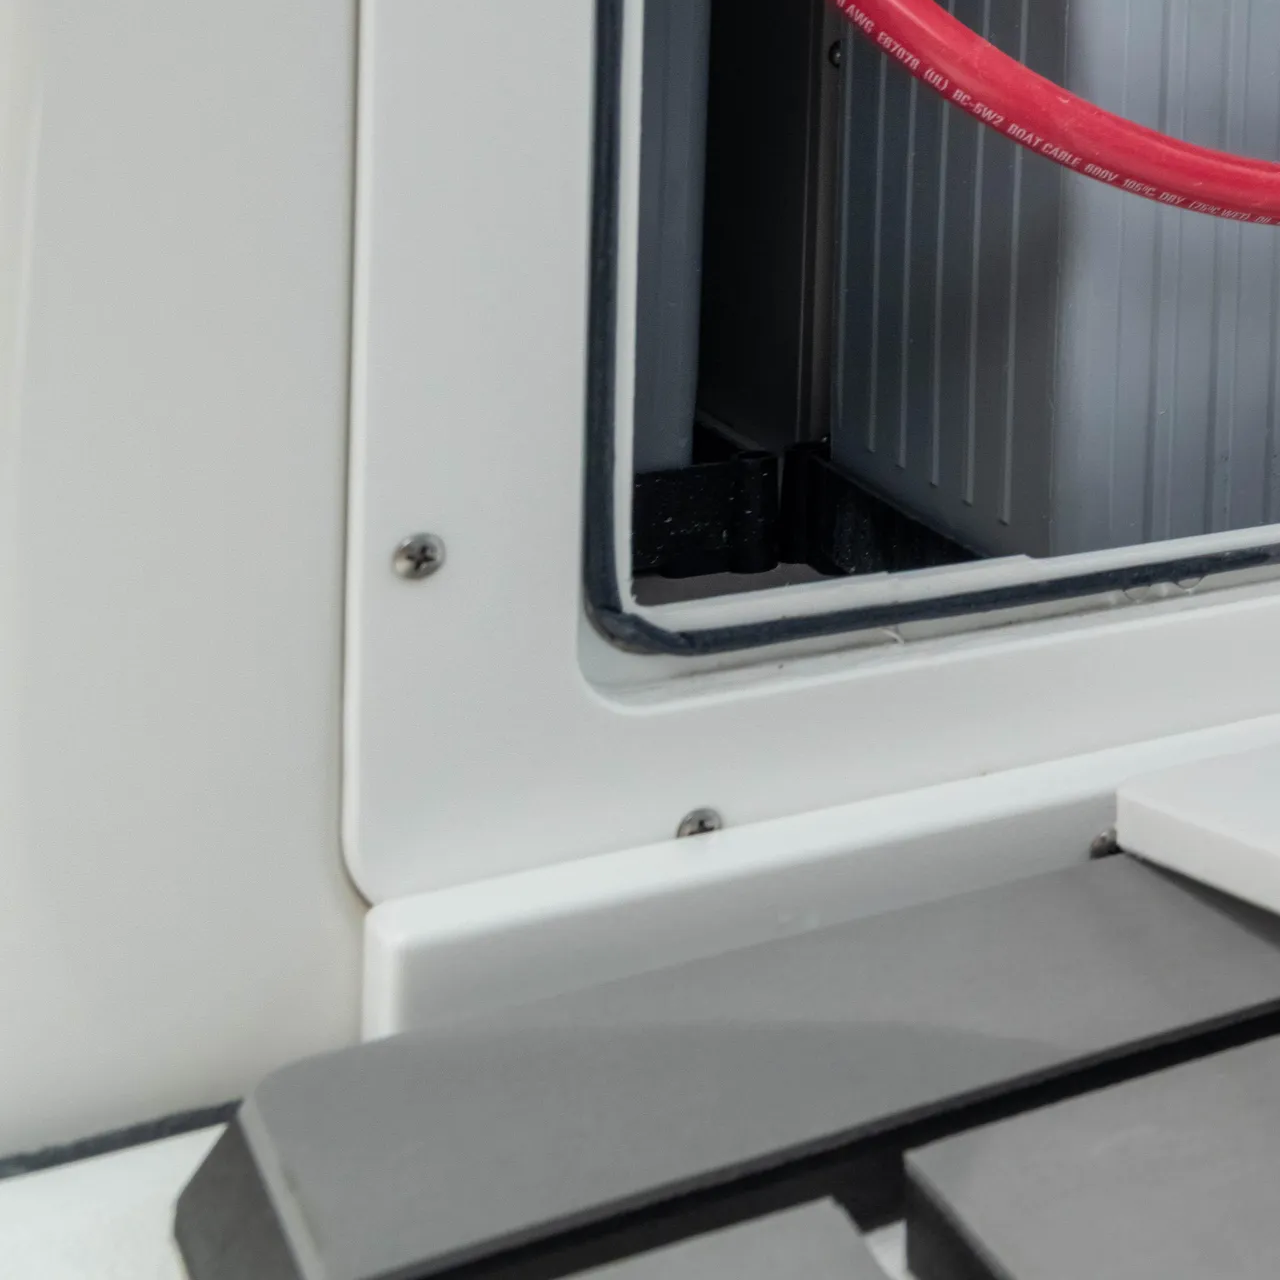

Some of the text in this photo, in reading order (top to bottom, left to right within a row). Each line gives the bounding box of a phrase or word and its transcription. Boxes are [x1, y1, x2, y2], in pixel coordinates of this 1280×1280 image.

[844, 3, 876, 35] AWG
[1007, 122, 1044, 148] BOAT
[1041, 142, 1082, 168] CABLE
